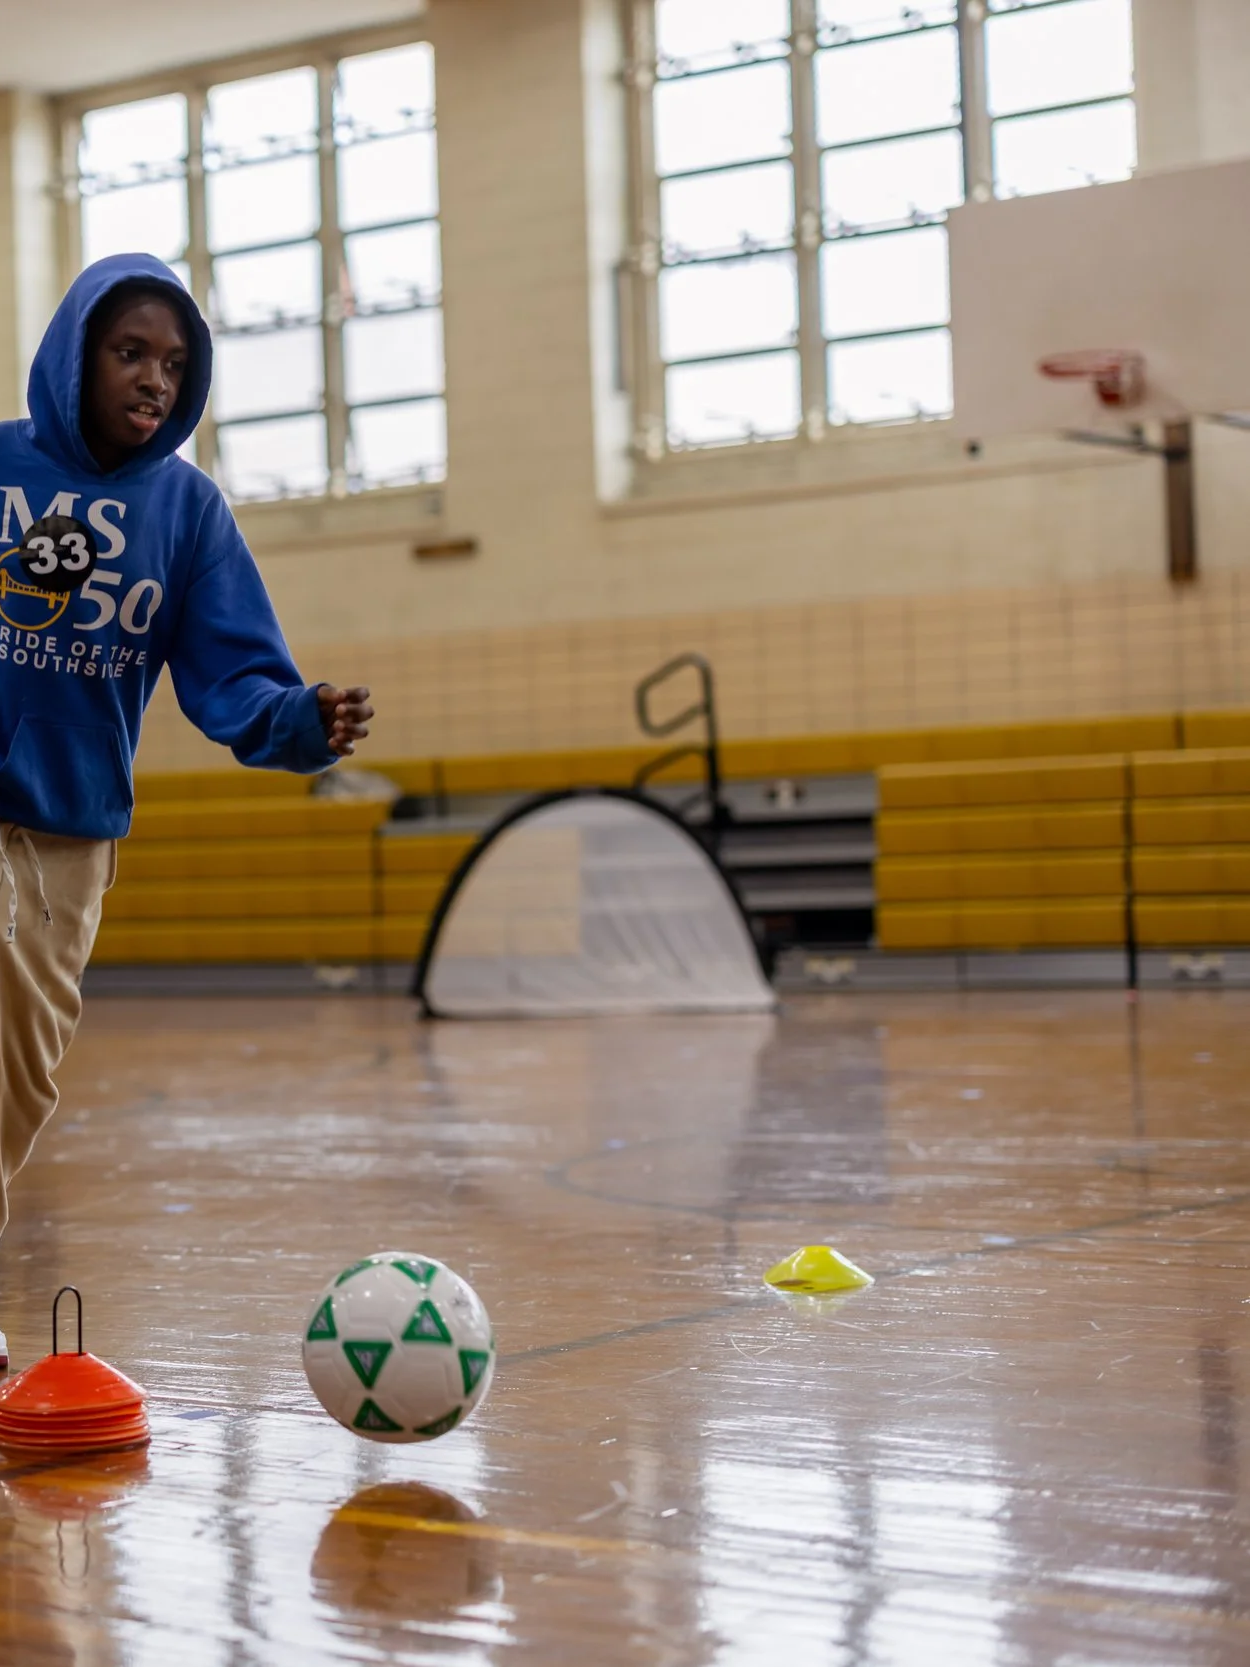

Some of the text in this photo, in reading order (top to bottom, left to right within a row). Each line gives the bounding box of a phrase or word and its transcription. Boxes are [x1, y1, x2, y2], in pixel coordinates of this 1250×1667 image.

[27, 532, 91, 574] 33
[73, 568, 164, 635] 50
[70, 641, 103, 661] OF
[111, 645, 147, 666] THE
